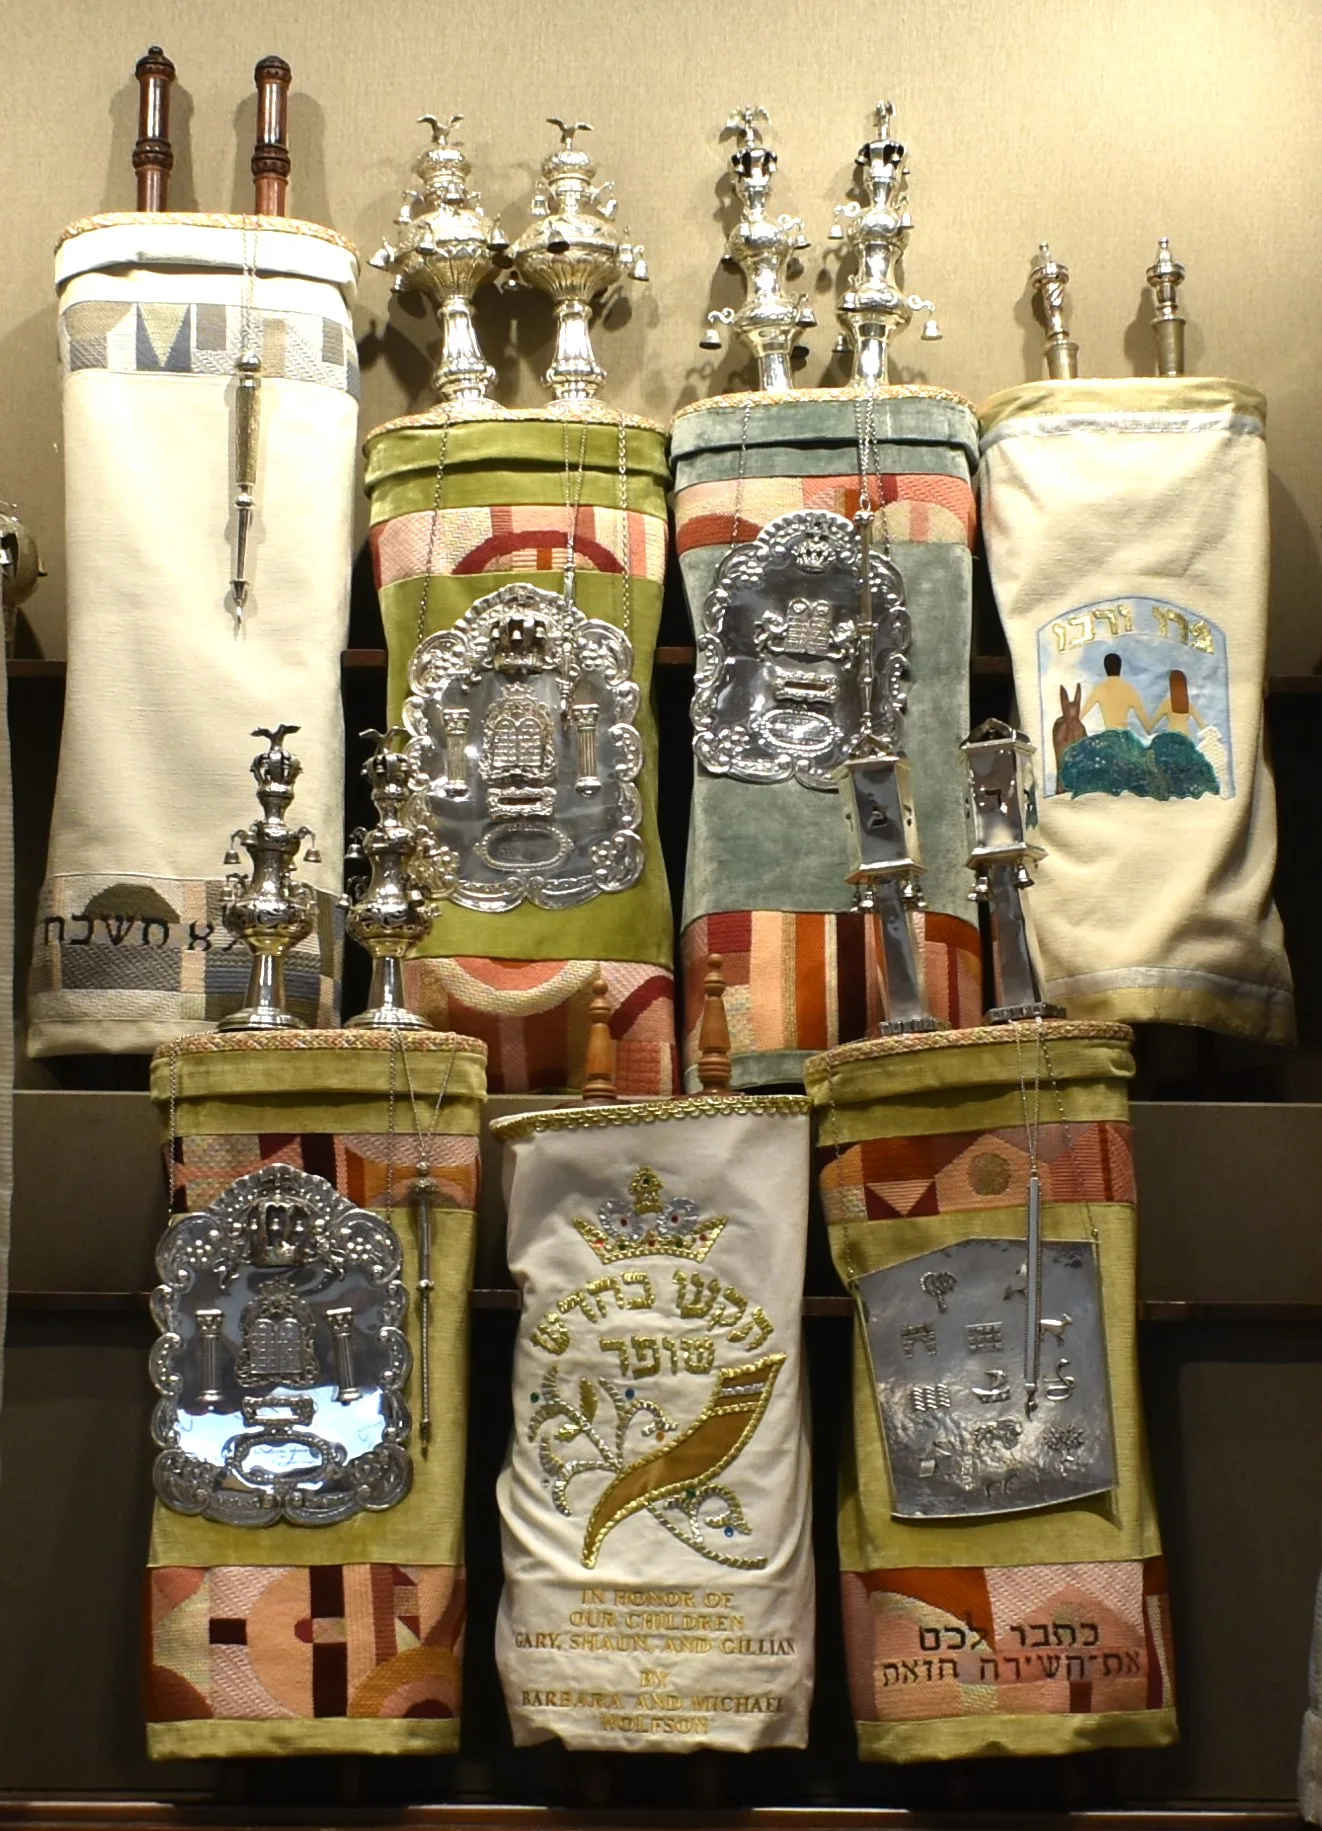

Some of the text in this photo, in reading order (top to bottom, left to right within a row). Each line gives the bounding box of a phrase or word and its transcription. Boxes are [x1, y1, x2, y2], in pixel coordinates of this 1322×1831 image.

[1052, 604, 1133, 652] ורבו
[599, 1335, 716, 1379] שופר
[582, 1588, 734, 1609] IN HONOR OF
[569, 1610, 745, 1632] OUR CHILDREN
[665, 1636, 712, 1654] AND
[640, 1668, 670, 1688] BY
[522, 1690, 623, 1710] BARBARA
[635, 1692, 682, 1711] AND
[601, 1714, 709, 1734] WOLFSON
